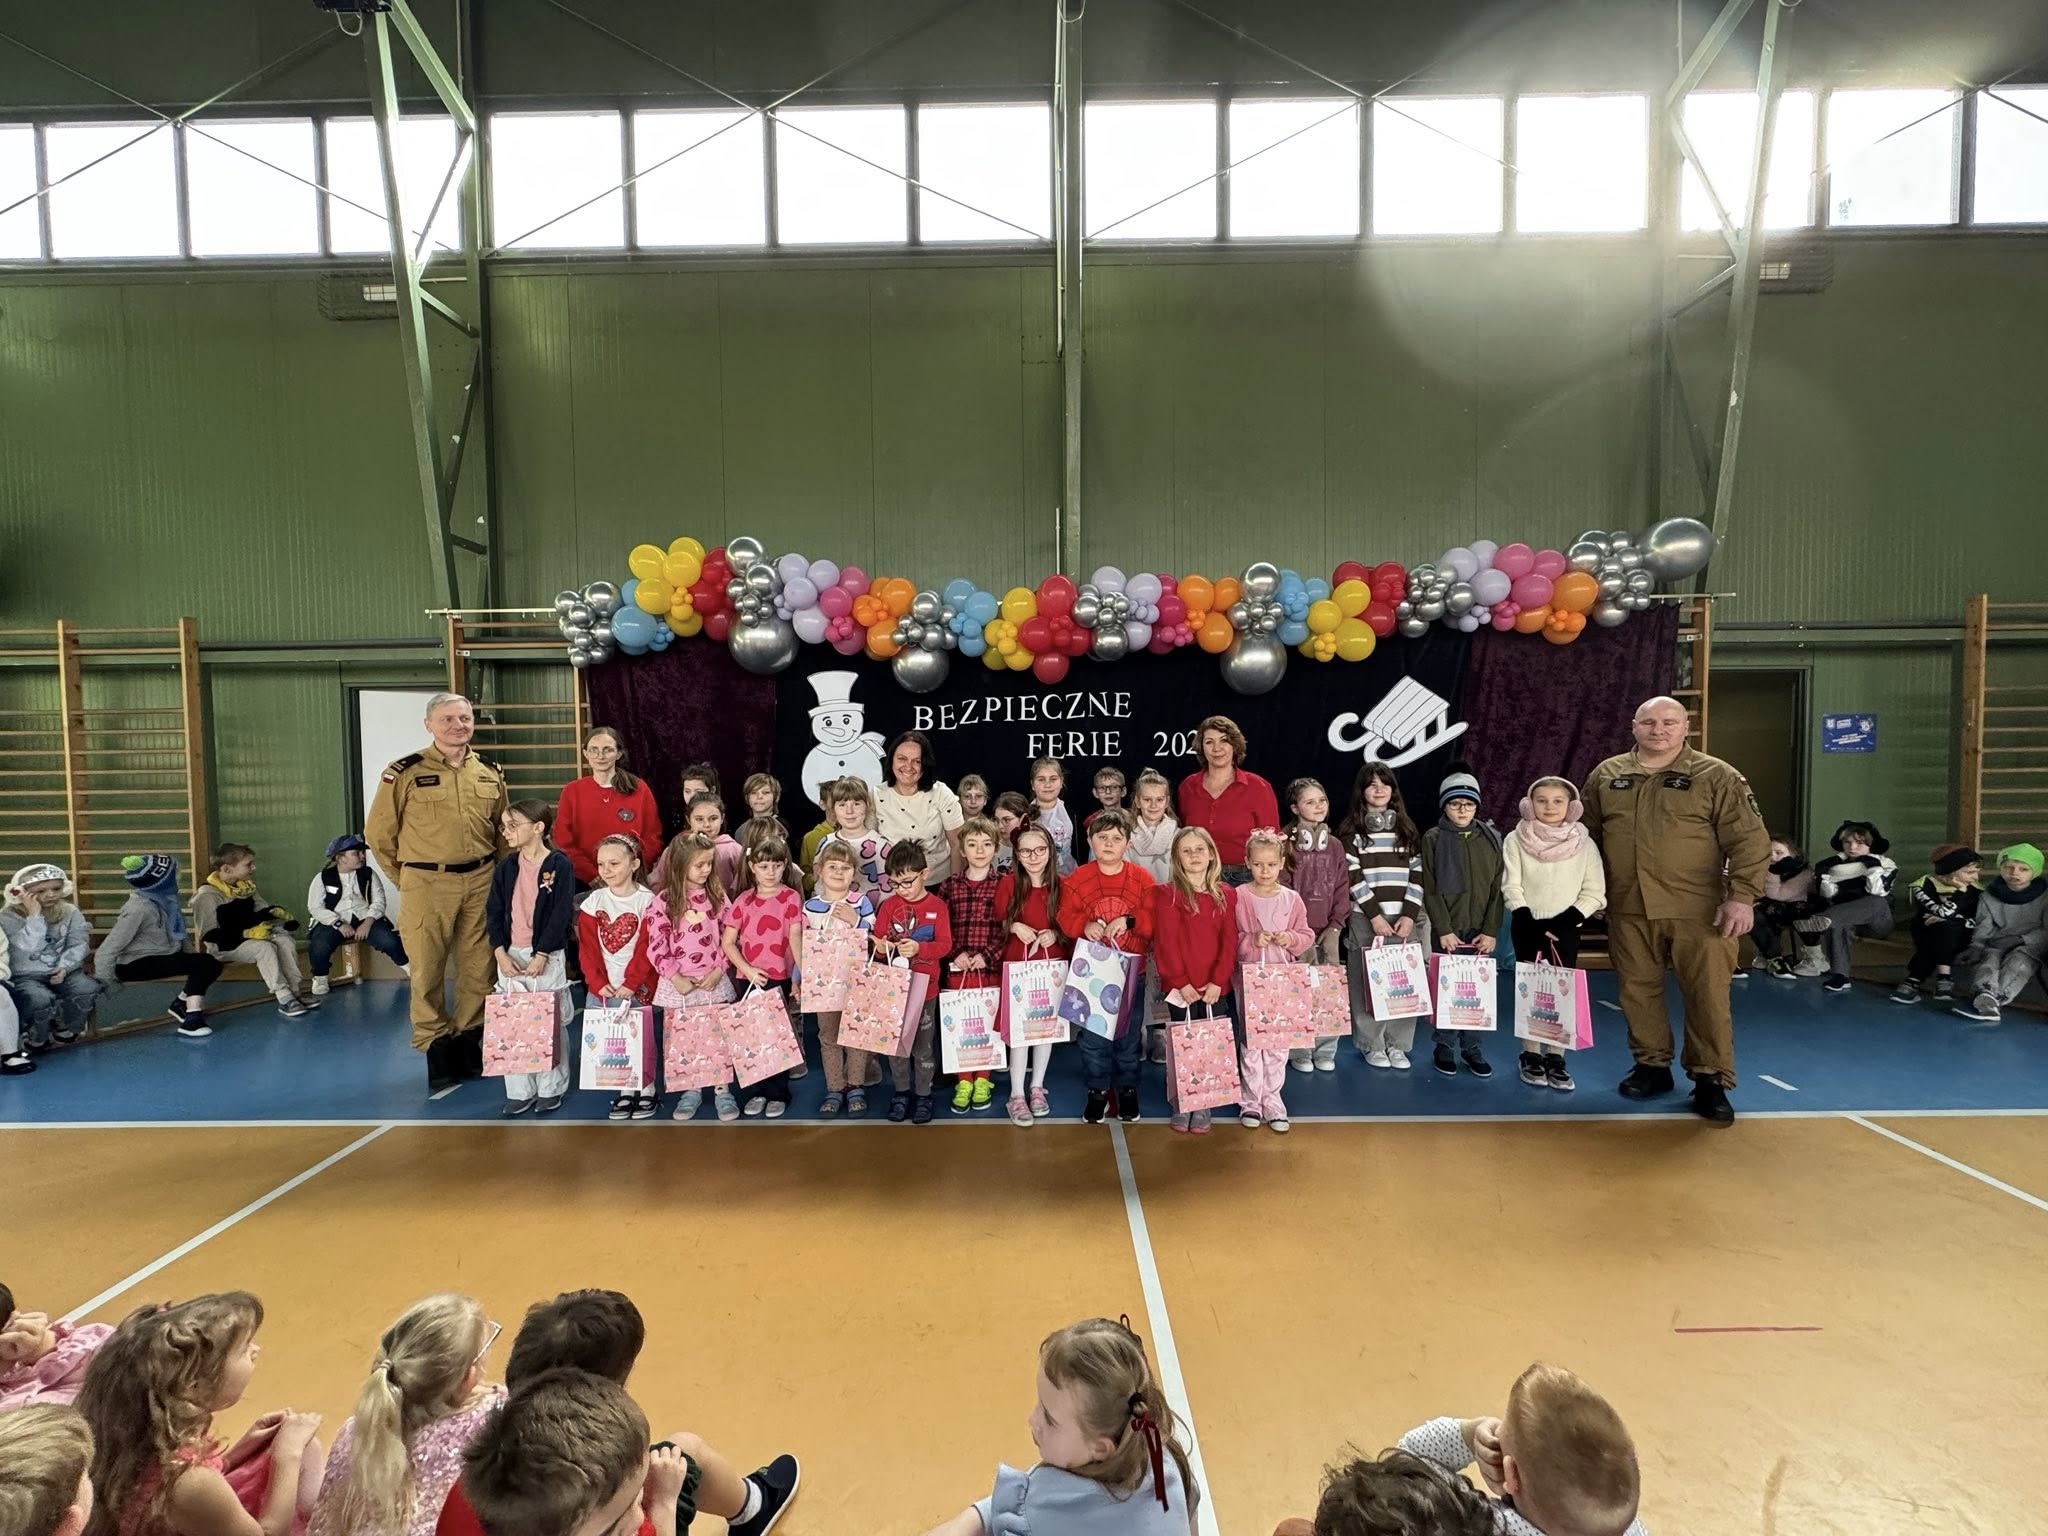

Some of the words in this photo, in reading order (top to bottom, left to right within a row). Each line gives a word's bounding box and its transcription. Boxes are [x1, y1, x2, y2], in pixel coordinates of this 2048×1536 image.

[912, 691, 1132, 731] BEZPIECZNE
[1026, 730, 1122, 760] FERIE
[1153, 729, 1198, 757] 202
[151, 854, 169, 877] GE
